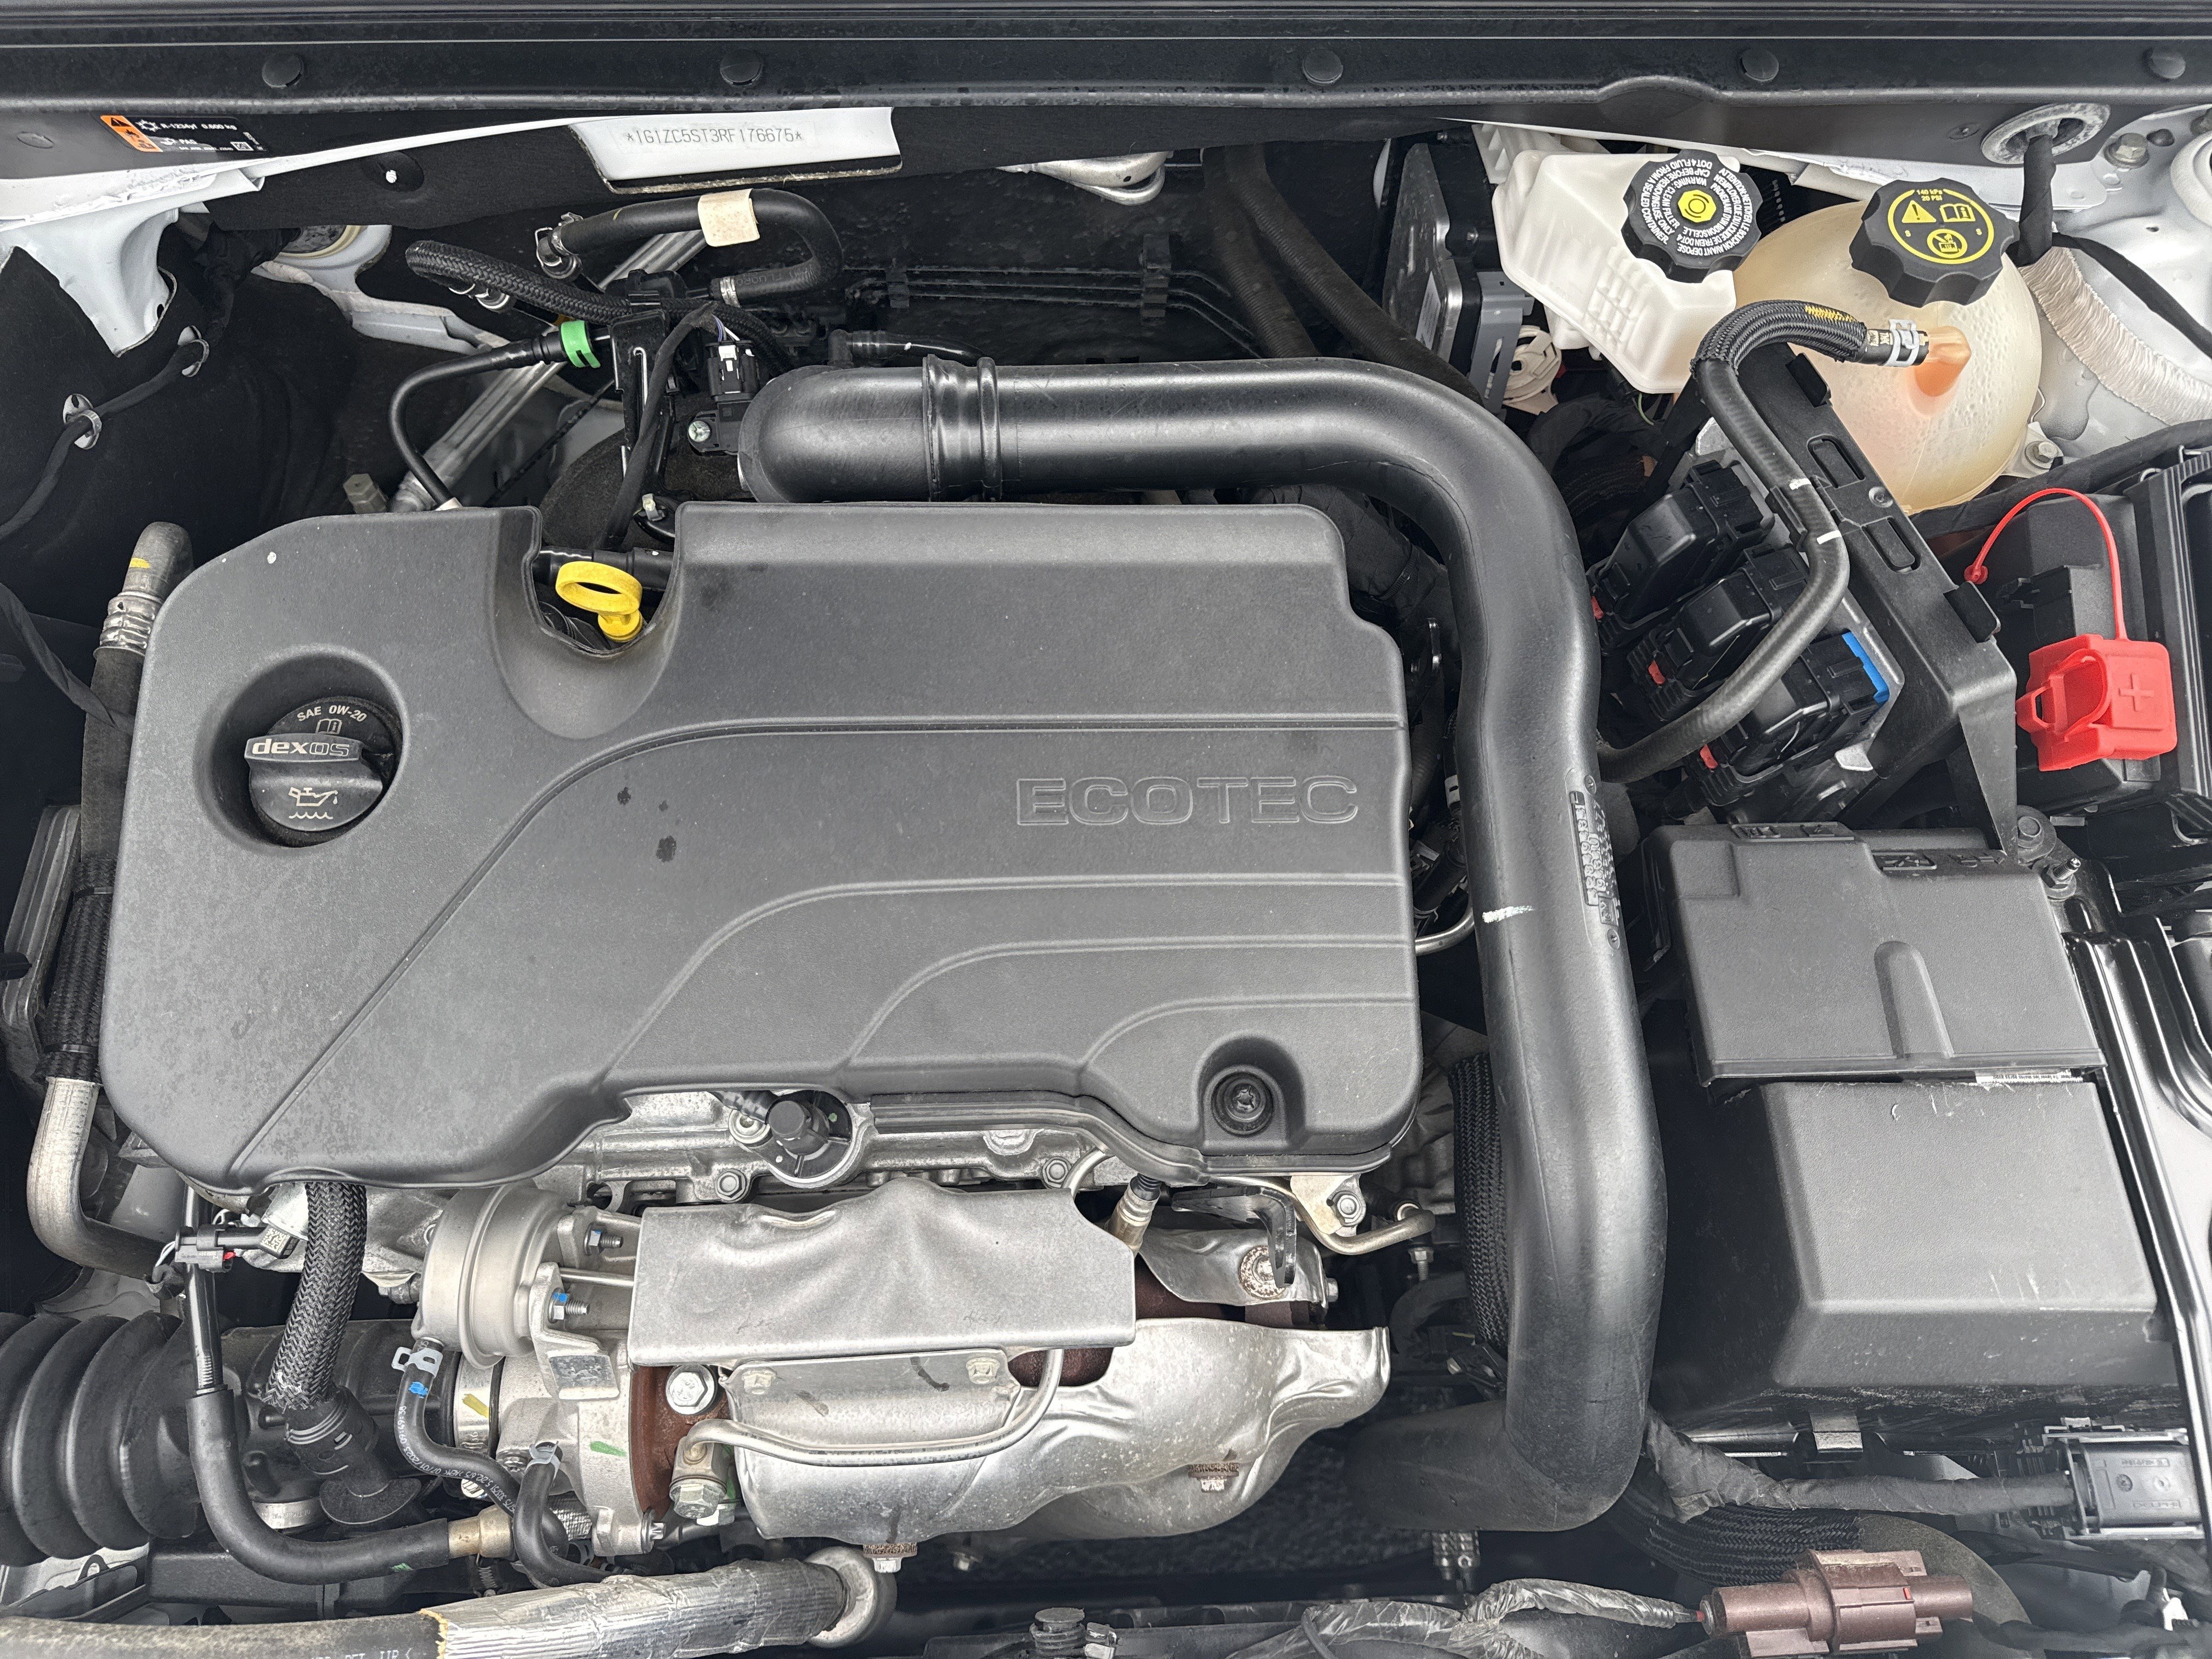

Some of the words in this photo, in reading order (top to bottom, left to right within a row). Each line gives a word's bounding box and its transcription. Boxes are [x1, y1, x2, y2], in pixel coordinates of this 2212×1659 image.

[1670, 159, 1691, 169] FLUID
[1696, 160, 1713, 170] DOT
[1651, 165, 1672, 180] FROM
[1666, 167, 1694, 181] BEFORE
[1694, 168, 1710, 177] CAP
[1640, 182, 1654, 207] SEALED
[1662, 187, 1675, 207] CLEAN
[1710, 182, 1732, 215] PROVENANT
[1662, 208, 1680, 229] FILLER
[1734, 205, 1742, 216] QUE
[1658, 219, 1675, 235] ONLY
[1719, 222, 1740, 241] LIQUIDE
[1741, 222, 1751, 232] LE
[1680, 236, 1694, 246] DOT
[1695, 238, 1714, 247] FREIN
[1712, 236, 1723, 245] DE
[1724, 229, 1747, 251] BOUCHON
[1704, 244, 1724, 256] AVANT
[297, 706, 322, 722] SAE
[329, 705, 367, 722] 0W-20
[252, 738, 350, 757] dexos
[1016, 775, 1358, 826] ECOTEC
[397, 1406, 407, 1444] 09:49:38
[403, 1447, 442, 1474] 07/01/2023
